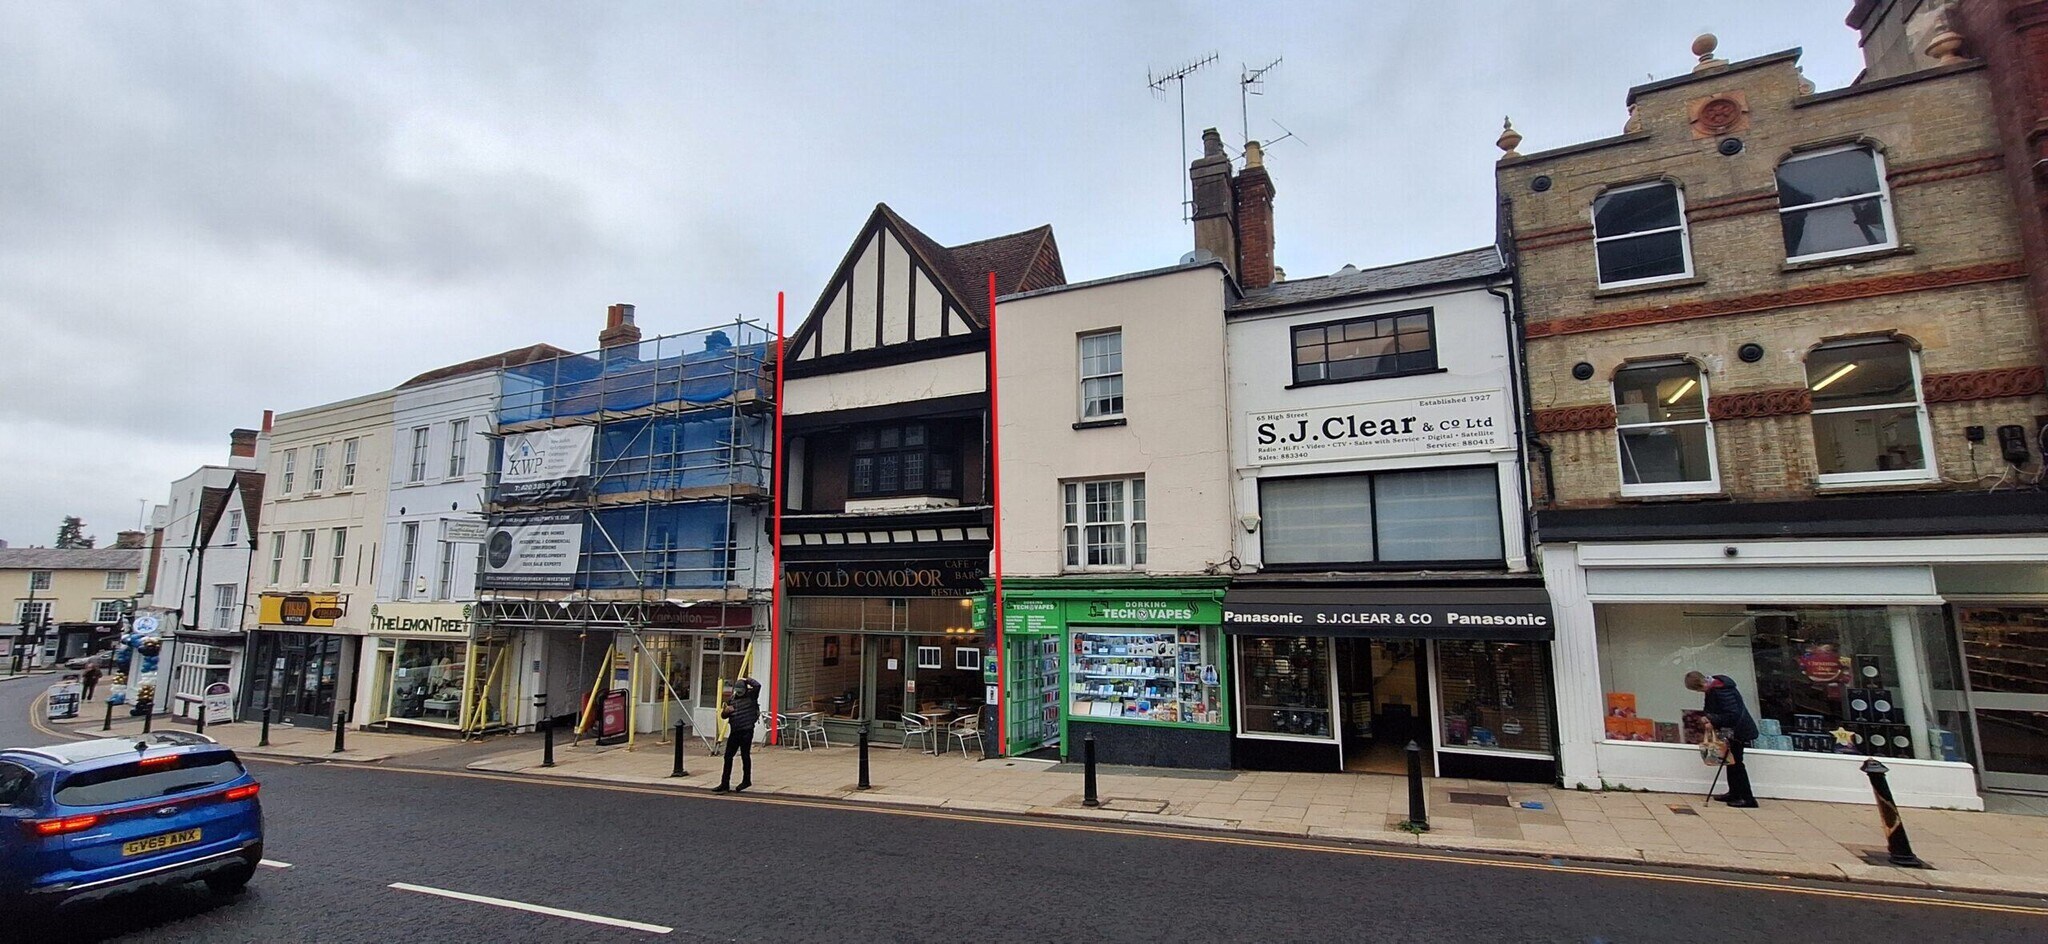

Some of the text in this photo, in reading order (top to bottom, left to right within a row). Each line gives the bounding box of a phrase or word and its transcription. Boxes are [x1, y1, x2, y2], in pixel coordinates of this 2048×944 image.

[1419, 394, 1491, 406] Established 1927
[1422, 422, 1434, 432] &
[1466, 417, 1494, 429] Ltd
[1427, 433, 1453, 441] Digital
[1461, 430, 1494, 438] Satellite
[1426, 438, 1495, 450] Service: 880415
[506, 457, 543, 476] KWP
[786, 569, 945, 588] MY OLD COMODOR
[955, 571, 976, 580] BAR
[1102, 609, 1136, 619] TECH
[1148, 609, 1192, 619] VAPES
[1224, 611, 1547, 626] Panasonic S.J.CLEAR & CO Panasonic
[396, 615, 433, 632] LEMON
[434, 616, 463, 632] TREE
[129, 829, 195, 853] GV69 ANX
